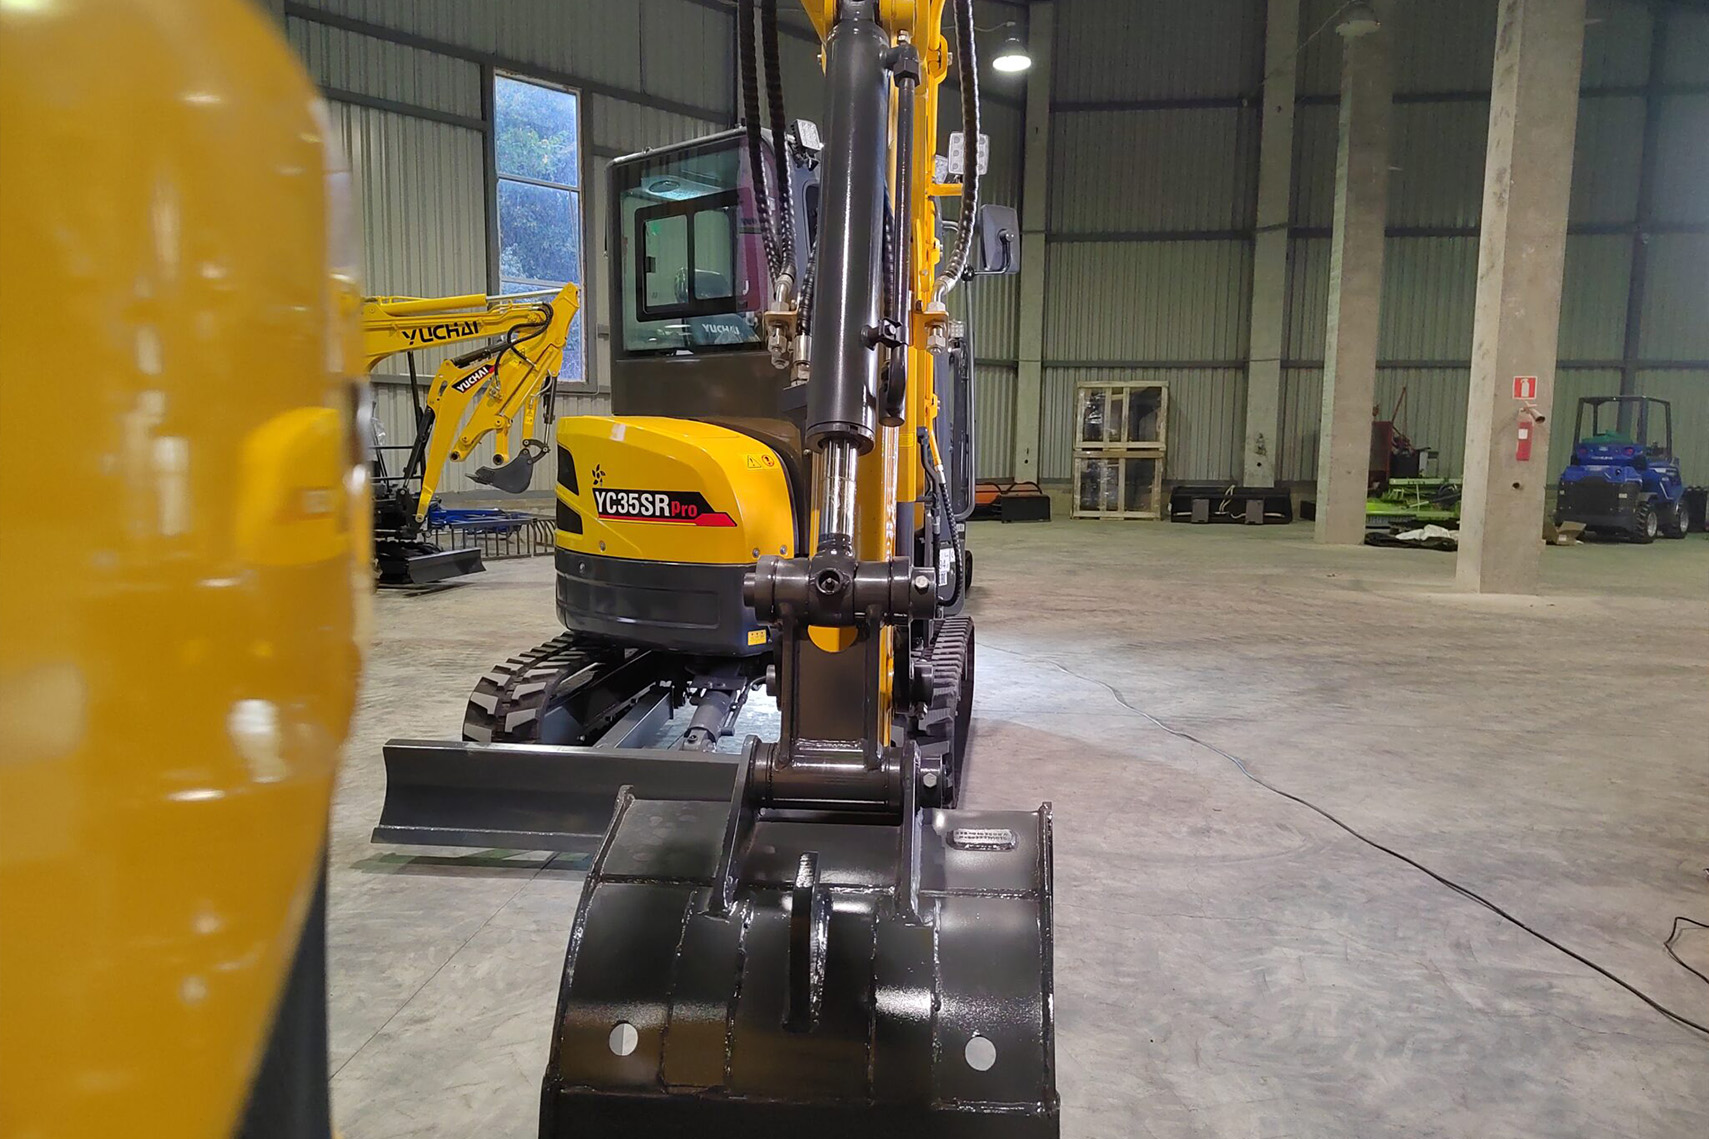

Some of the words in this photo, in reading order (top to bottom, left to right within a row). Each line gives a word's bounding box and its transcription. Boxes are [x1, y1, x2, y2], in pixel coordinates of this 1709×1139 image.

[401, 321, 479, 346] YUCHAI
[457, 366, 489, 393] YUCHAI
[595, 491, 670, 517] YC35SR
[671, 501, 698, 517] Pro
